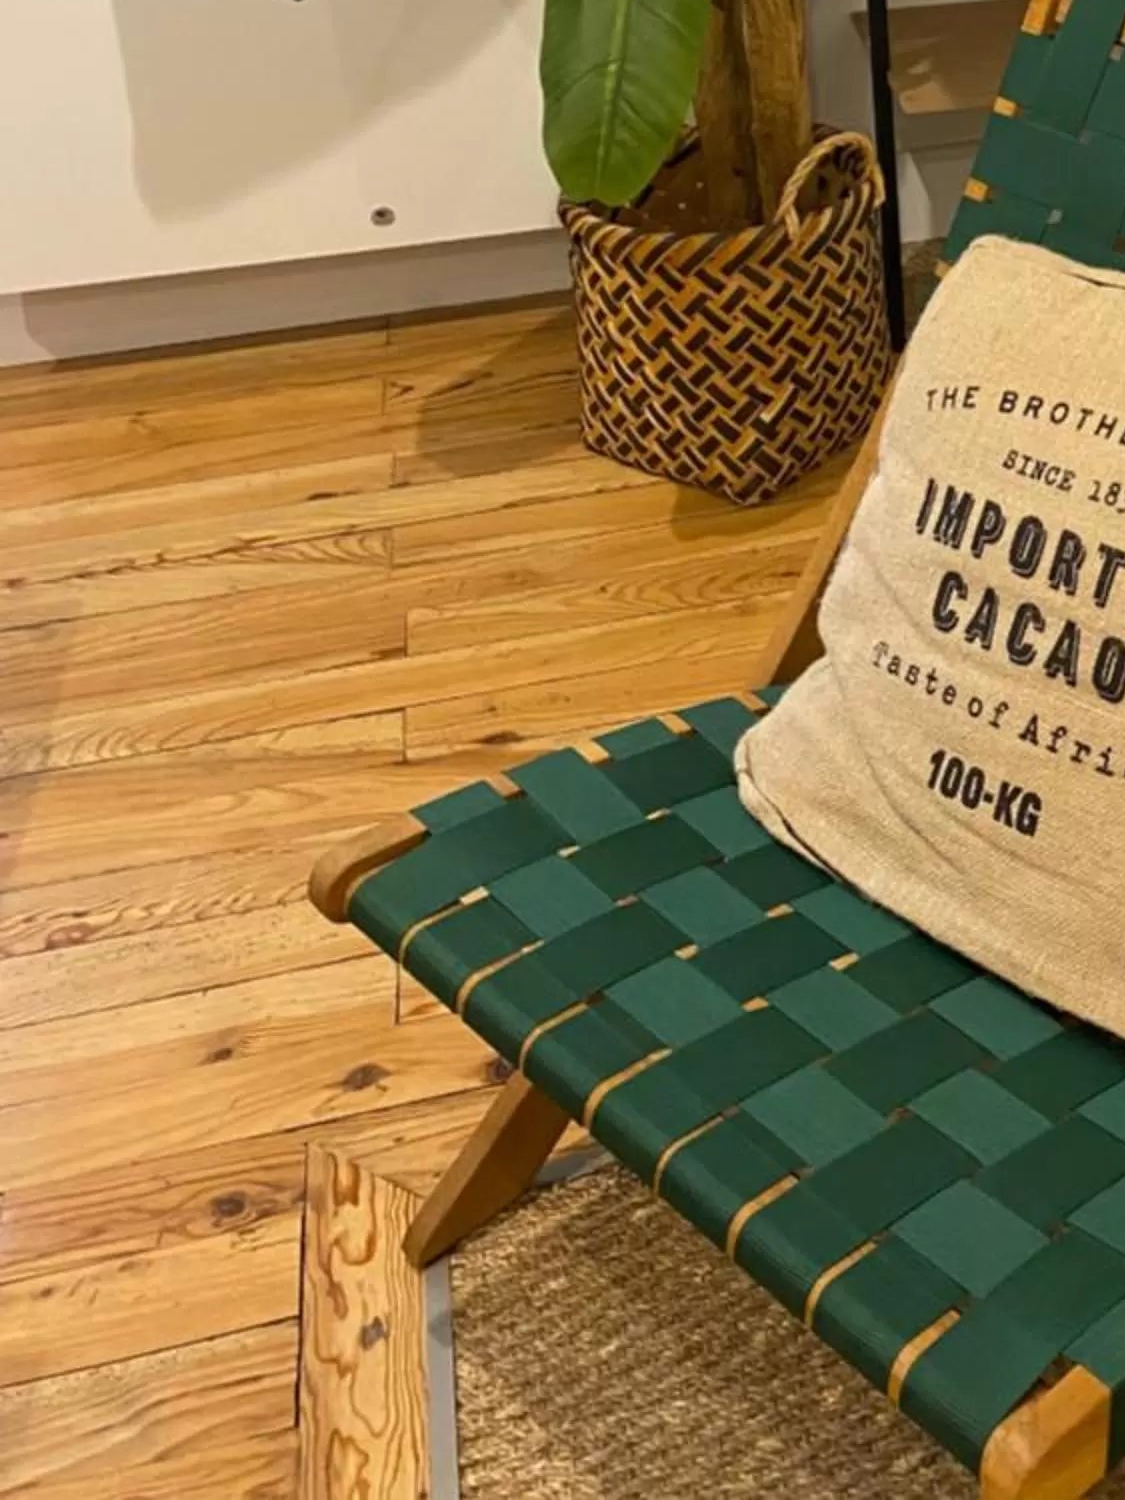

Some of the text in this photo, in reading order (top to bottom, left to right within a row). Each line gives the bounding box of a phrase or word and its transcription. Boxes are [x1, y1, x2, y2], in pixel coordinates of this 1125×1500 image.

[925, 385, 980, 412] THE
[1001, 449, 1075, 491] SINCE
[871, 640, 957, 704] Taste
[967, 695, 1009, 728] of
[927, 748, 1044, 837] 100-KG
